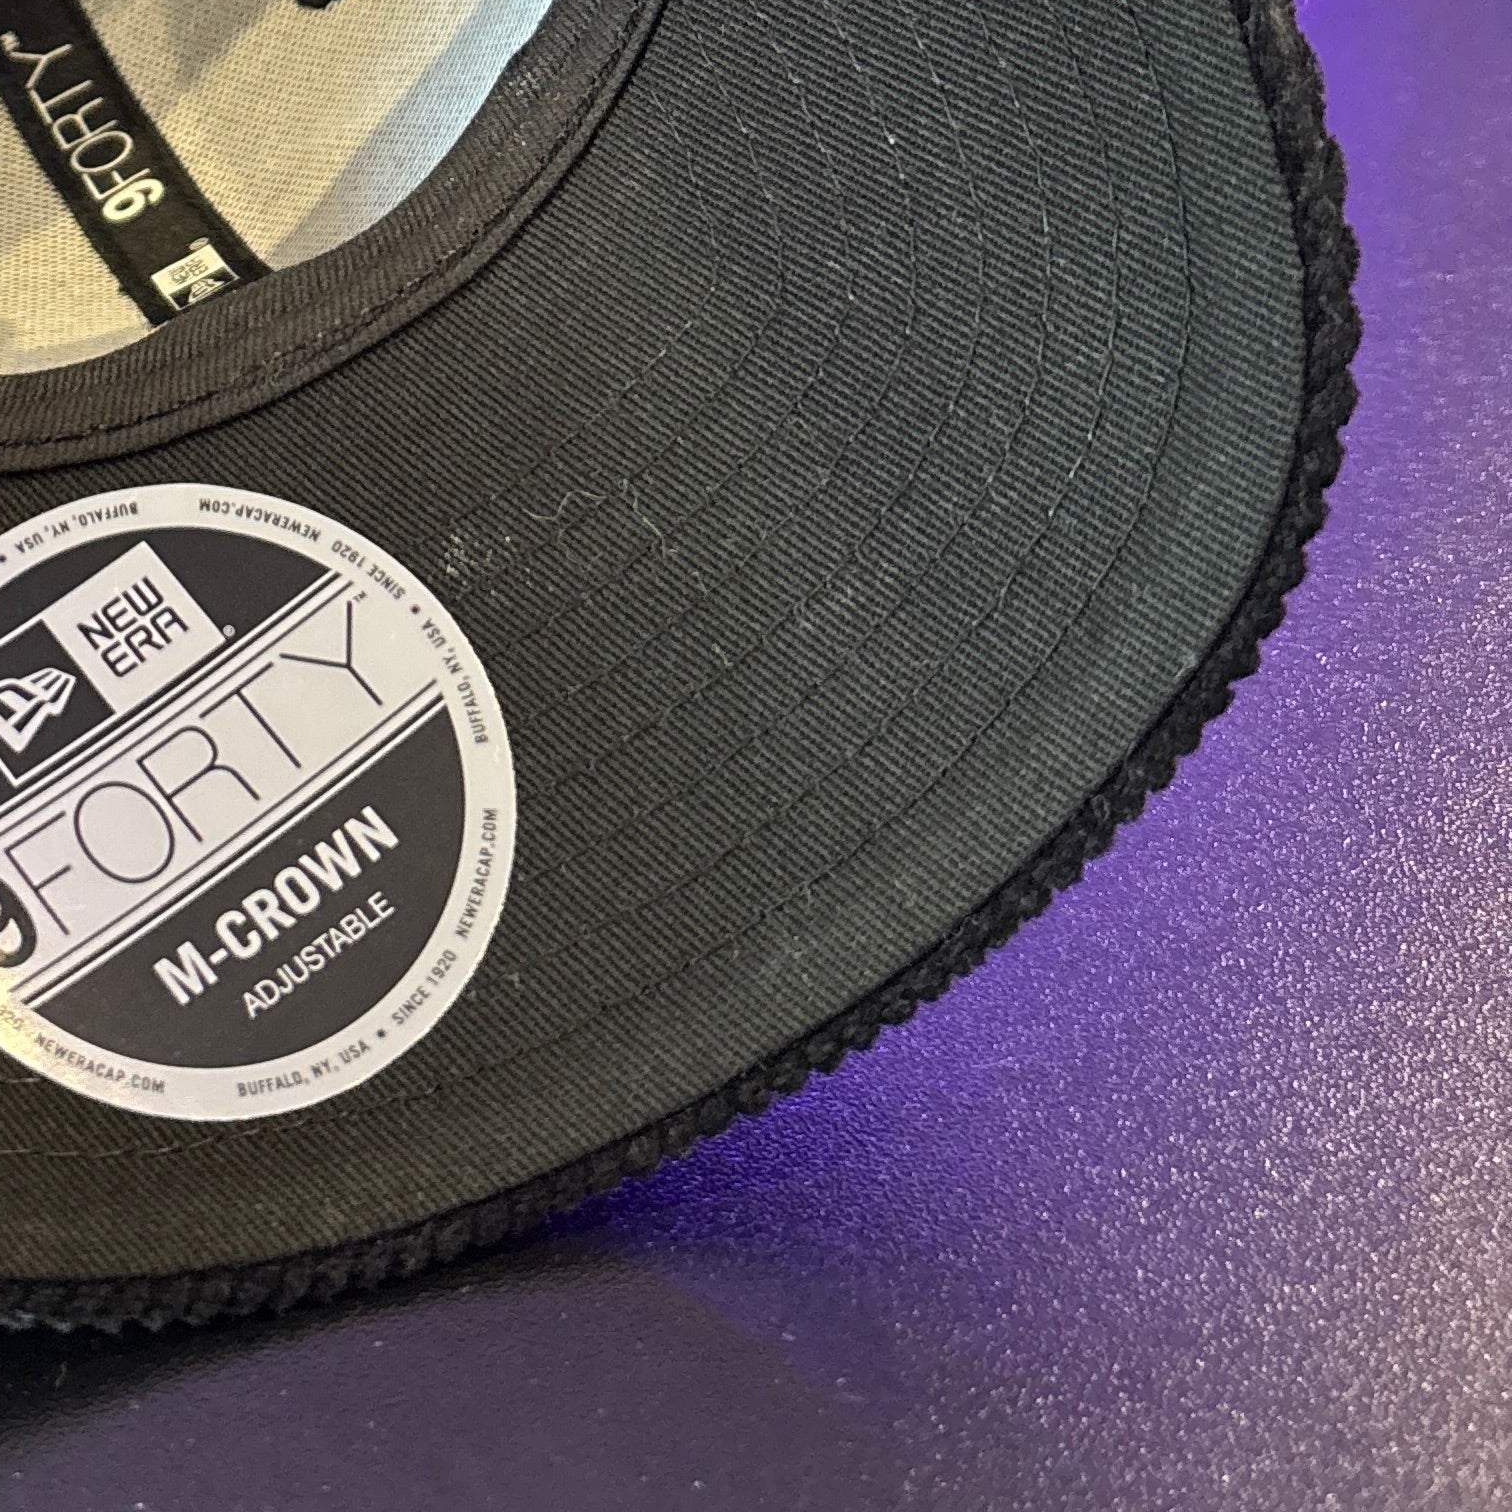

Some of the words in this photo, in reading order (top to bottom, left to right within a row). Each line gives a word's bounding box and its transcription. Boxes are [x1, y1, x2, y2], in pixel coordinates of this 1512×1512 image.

[14, 531, 45, 555] USA
[198, 497, 322, 543] NEWERACAP.COM
[331, 539, 366, 569] 1920
[367, 563, 407, 602] SINCE
[77, 577, 165, 651] NEW
[100, 605, 189, 678] ERA
[420, 616, 448, 650] USA
[454, 807, 499, 940] NEWERACAP.COM
[153, 805, 400, 1006] M-CROWN
[242, 890, 396, 1021] ADJUSTABLE
[391, 986, 431, 1026] SINCE
[425, 948, 458, 987] 1920
[339, 1039, 371, 1064] USA
